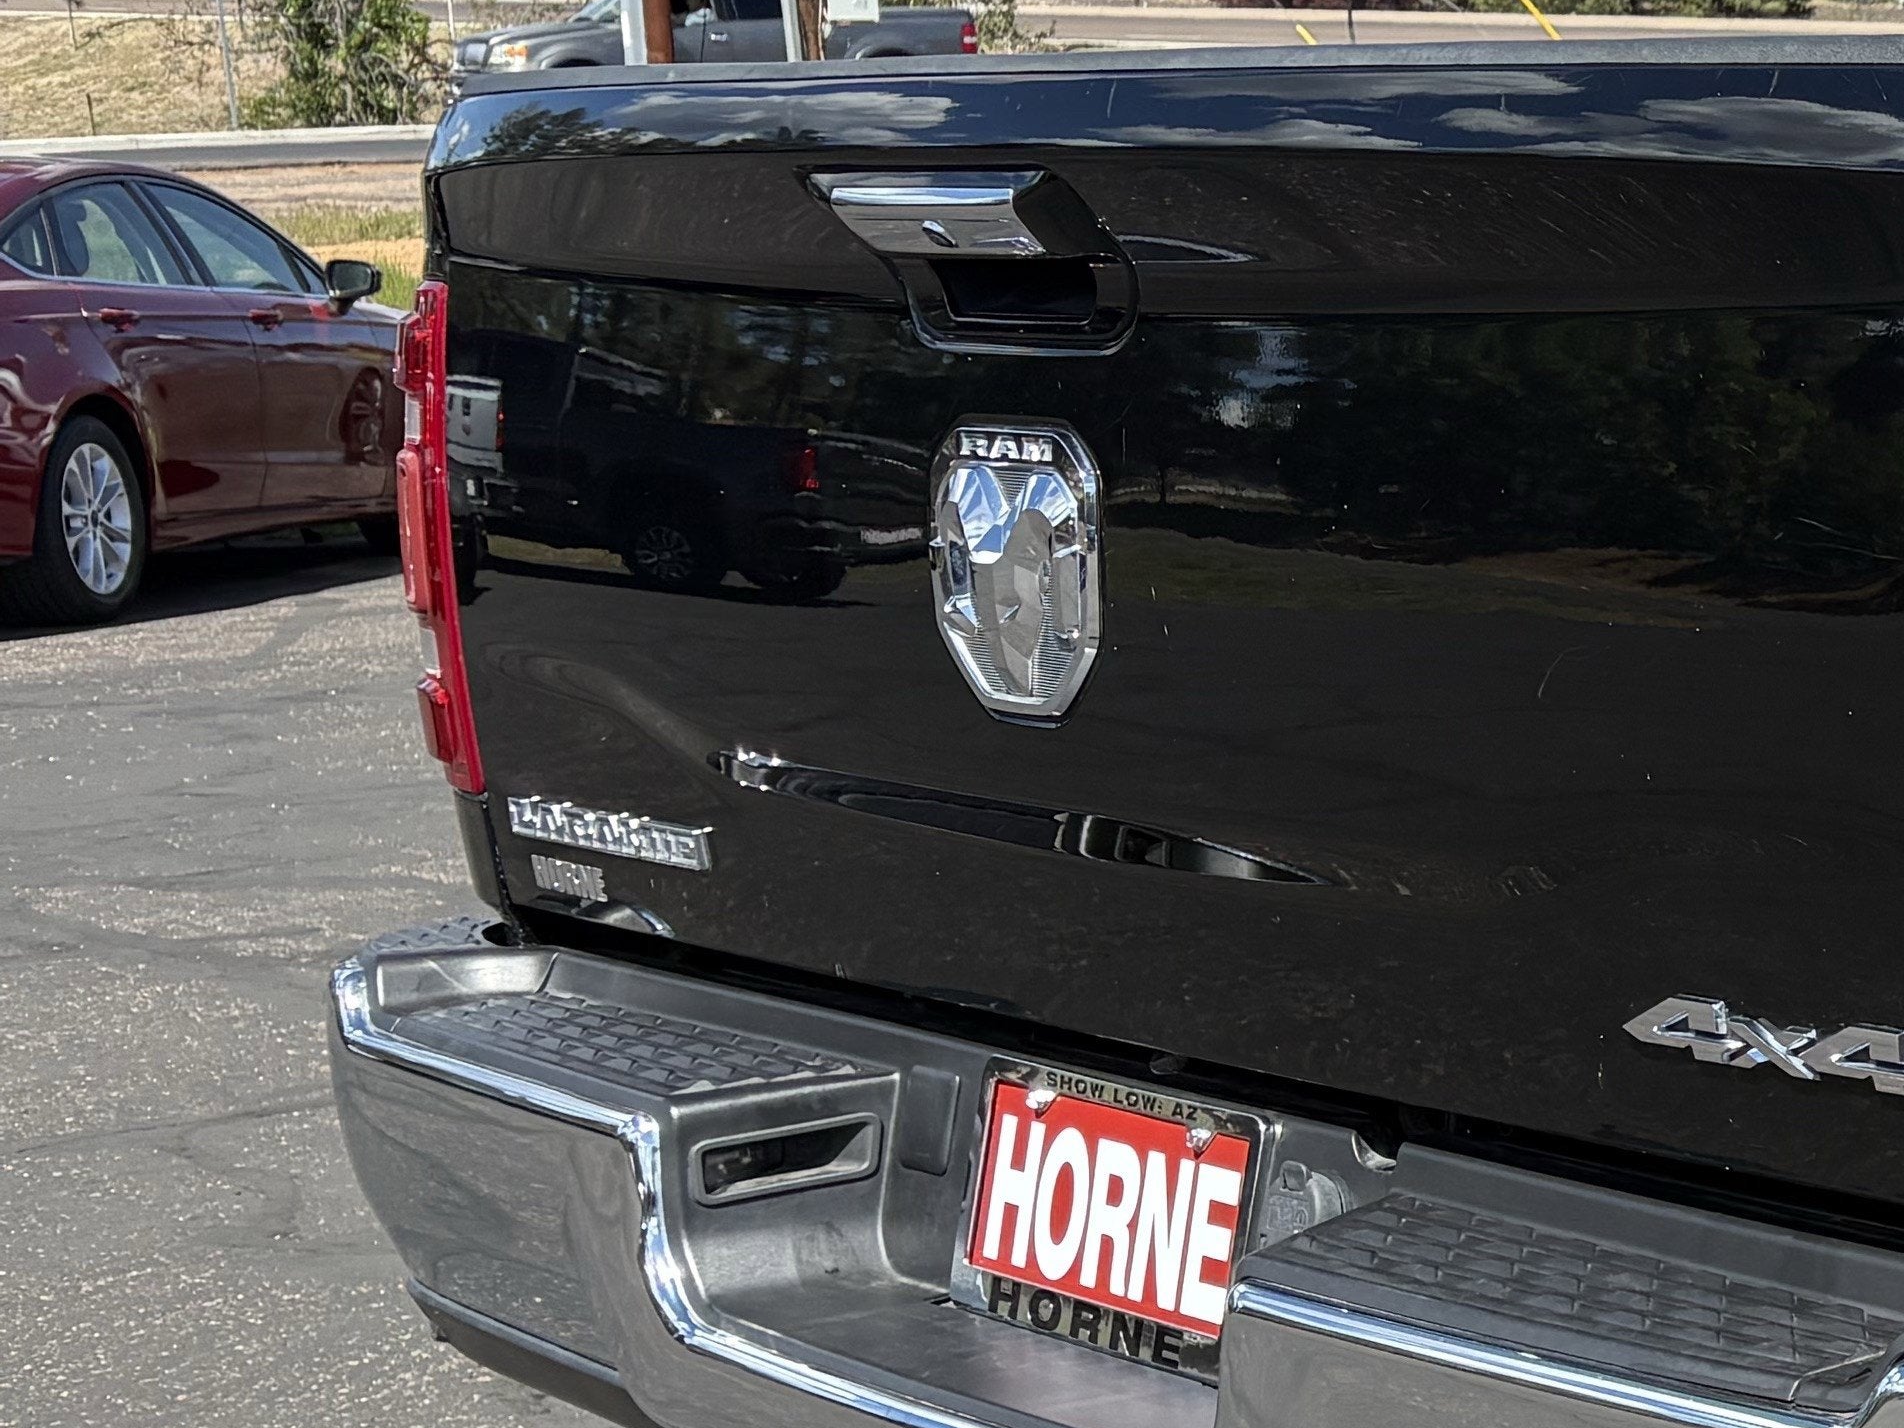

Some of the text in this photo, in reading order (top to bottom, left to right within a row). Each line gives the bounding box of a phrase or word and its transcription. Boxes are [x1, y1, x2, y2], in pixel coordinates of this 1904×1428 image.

[958, 432, 1053, 462] RAM
[1046, 1071, 1105, 1099] SHOW
[1171, 1102, 1199, 1121] AZ
[982, 1113, 1243, 1327] HORNE
[987, 1275, 1184, 1370] HORNE
